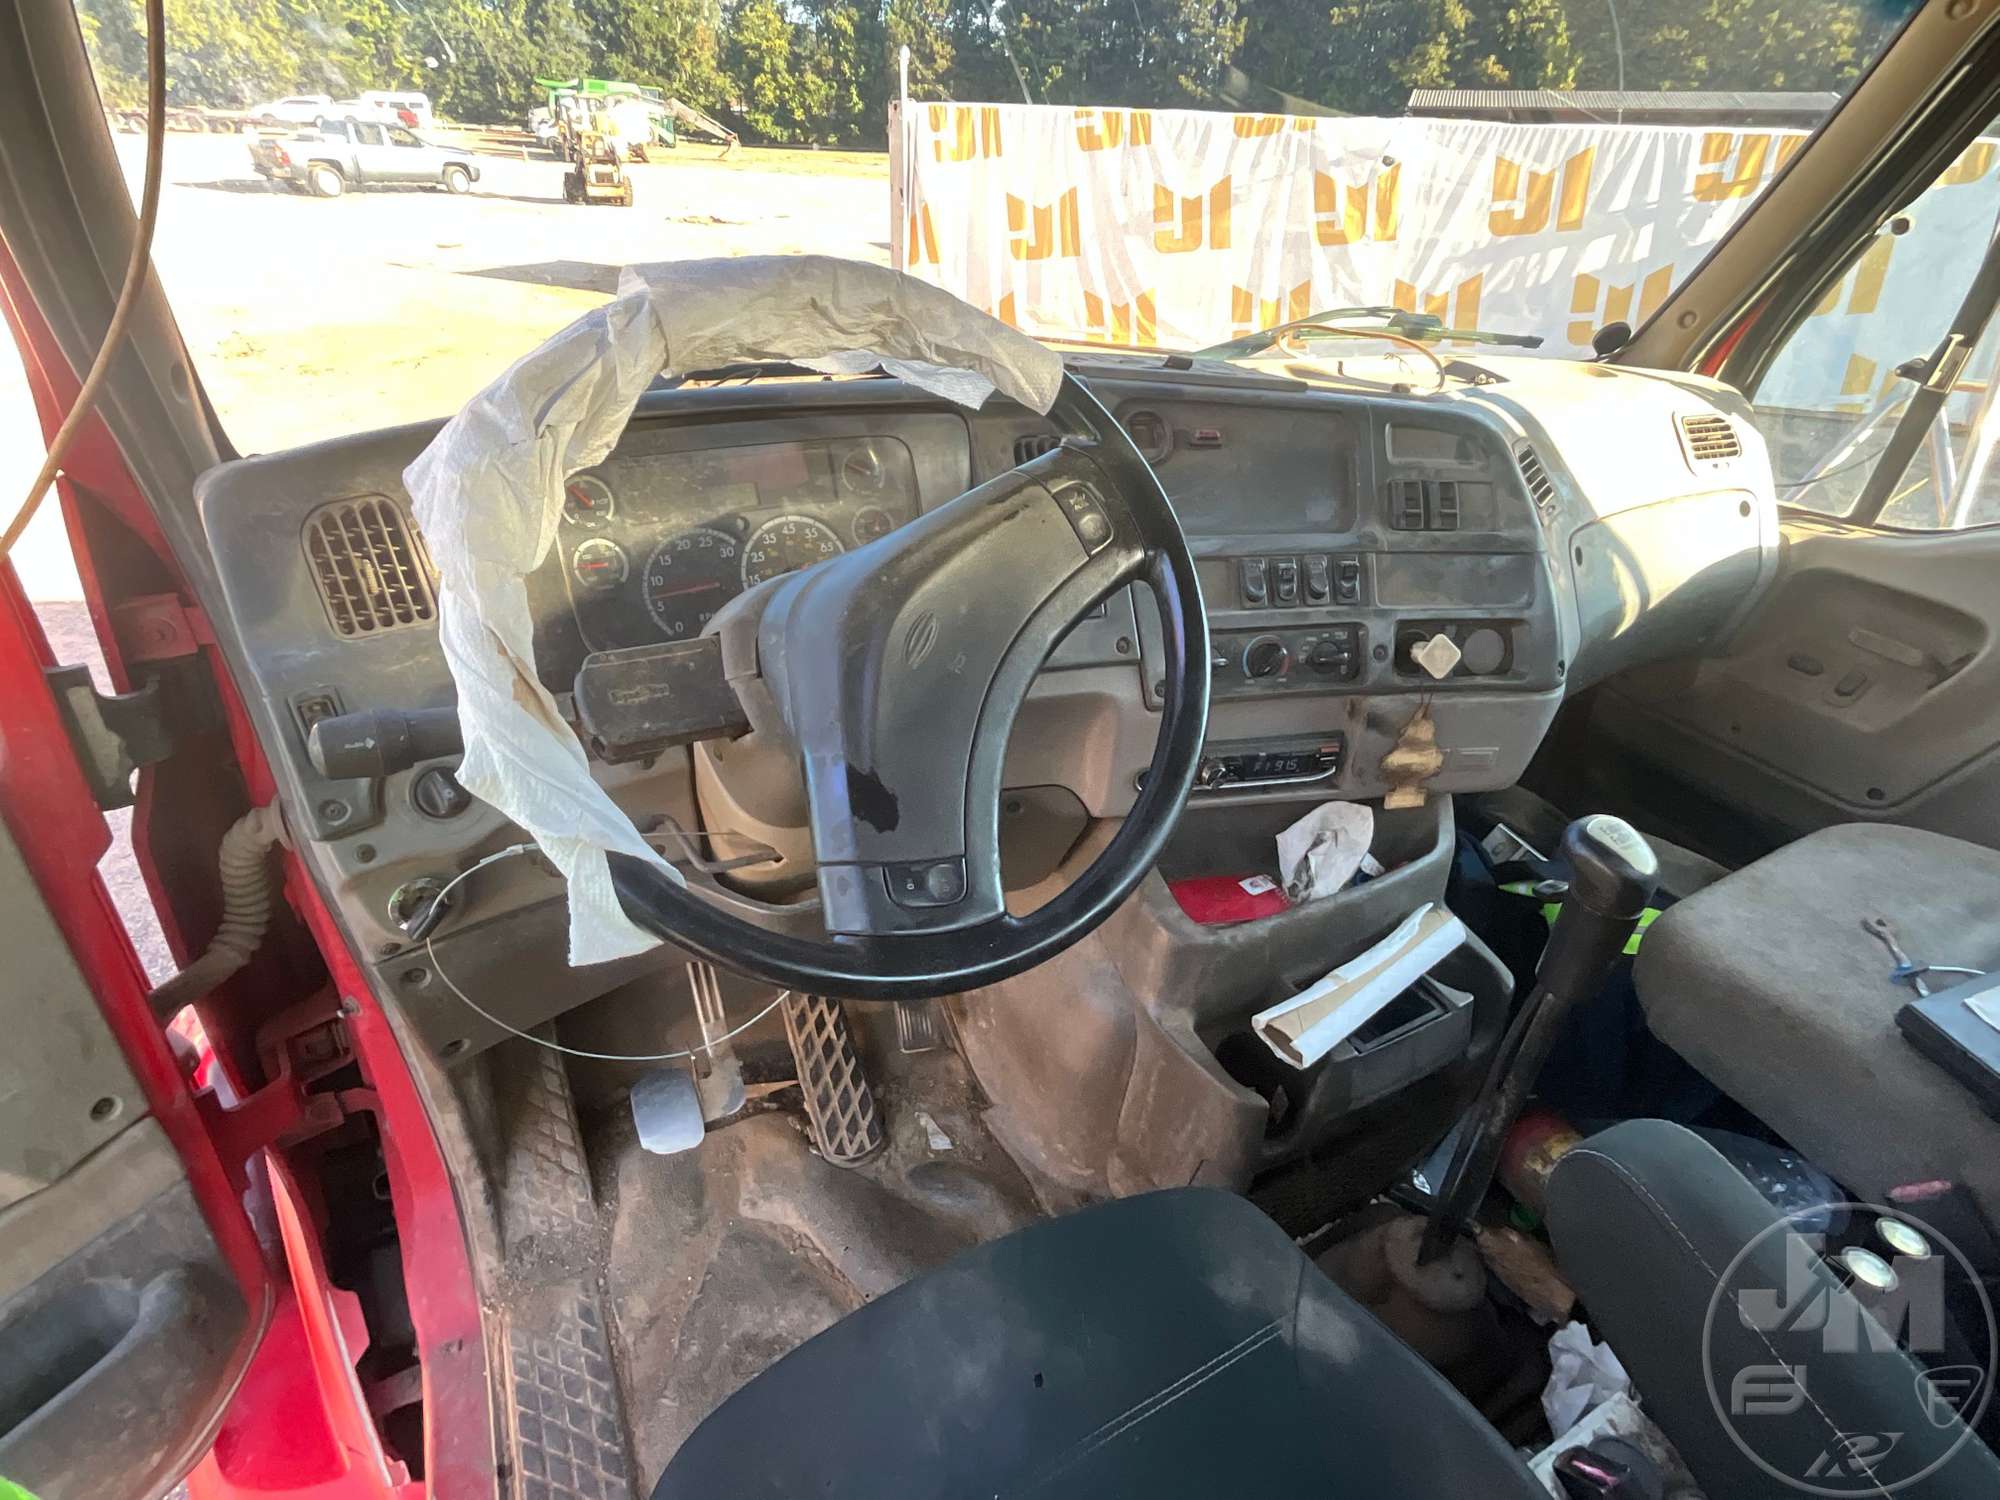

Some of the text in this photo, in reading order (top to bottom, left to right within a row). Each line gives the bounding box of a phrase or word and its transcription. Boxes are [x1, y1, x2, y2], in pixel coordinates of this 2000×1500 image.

[782, 523, 796, 535] 45
[804, 528, 818, 539] 55
[675, 539, 691, 551] 20
[698, 536, 713, 548] 25
[762, 534, 777, 545] 35
[720, 548, 735, 558] 30
[820, 542, 834, 553] 65
[659, 555, 672, 566] 15
[751, 551, 765, 563] 25
[650, 576, 664, 587] 10
[749, 575, 761, 586] 15
[657, 601, 665, 612] 5
[675, 622, 684, 633] 0
